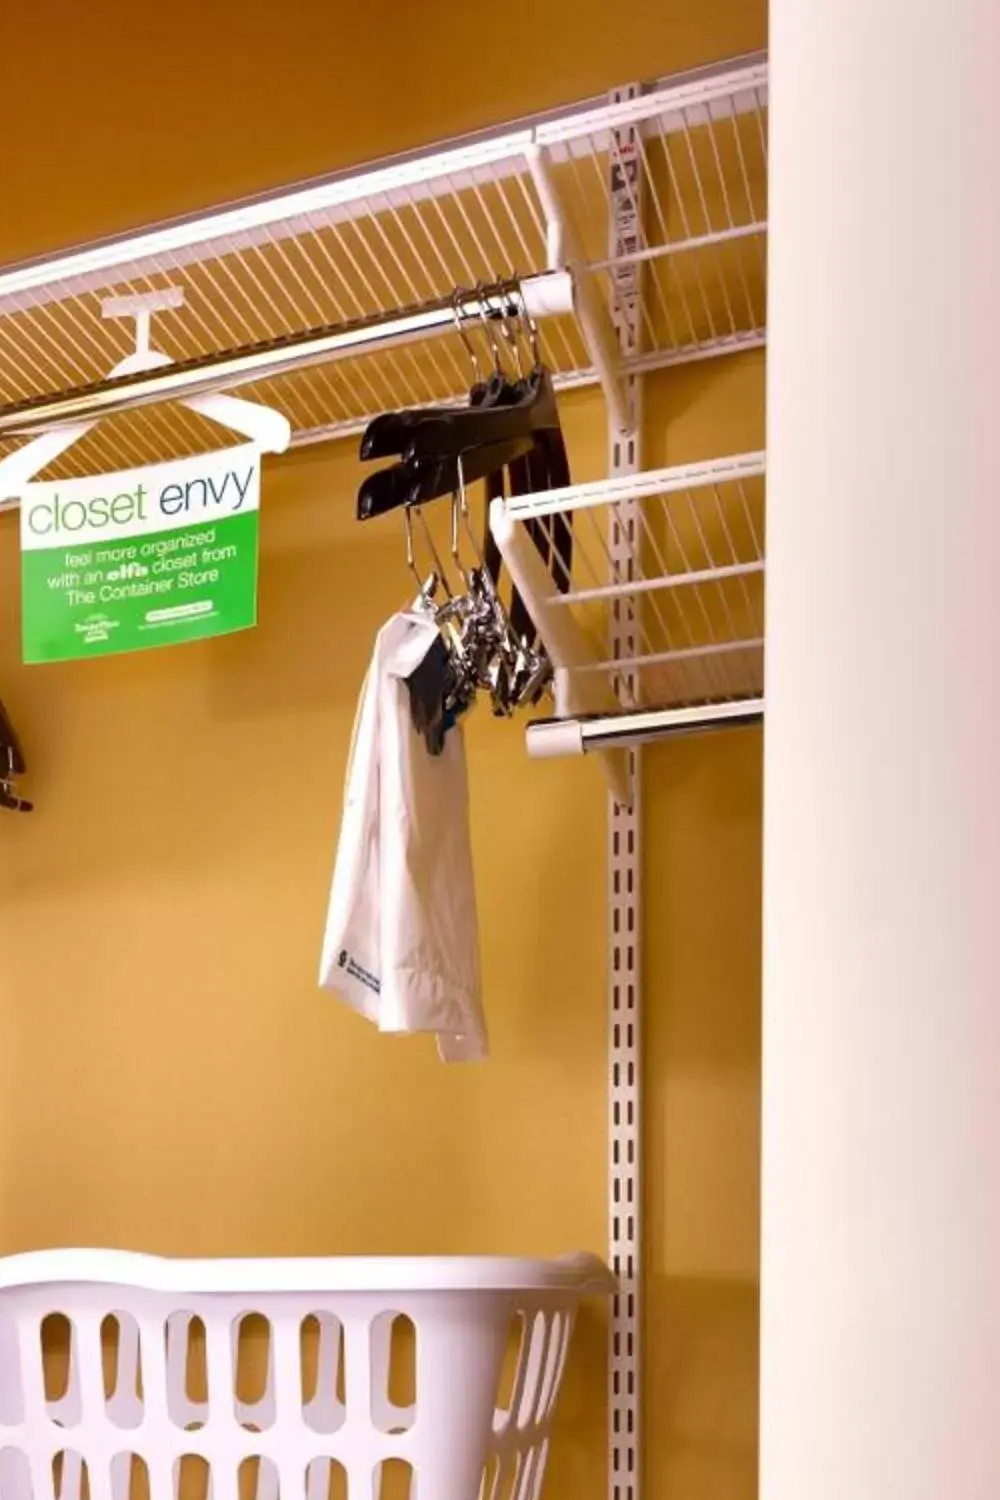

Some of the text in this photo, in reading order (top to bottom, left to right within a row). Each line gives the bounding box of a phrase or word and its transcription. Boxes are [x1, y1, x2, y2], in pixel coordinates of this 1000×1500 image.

[28, 466, 255, 535] closet envy
[47, 571, 81, 589] with
[84, 570, 104, 585] an
[152, 553, 198, 574] closet
[202, 544, 237, 564] from
[65, 526, 216, 568] feel more organized
[67, 568, 219, 606] The Container Store
